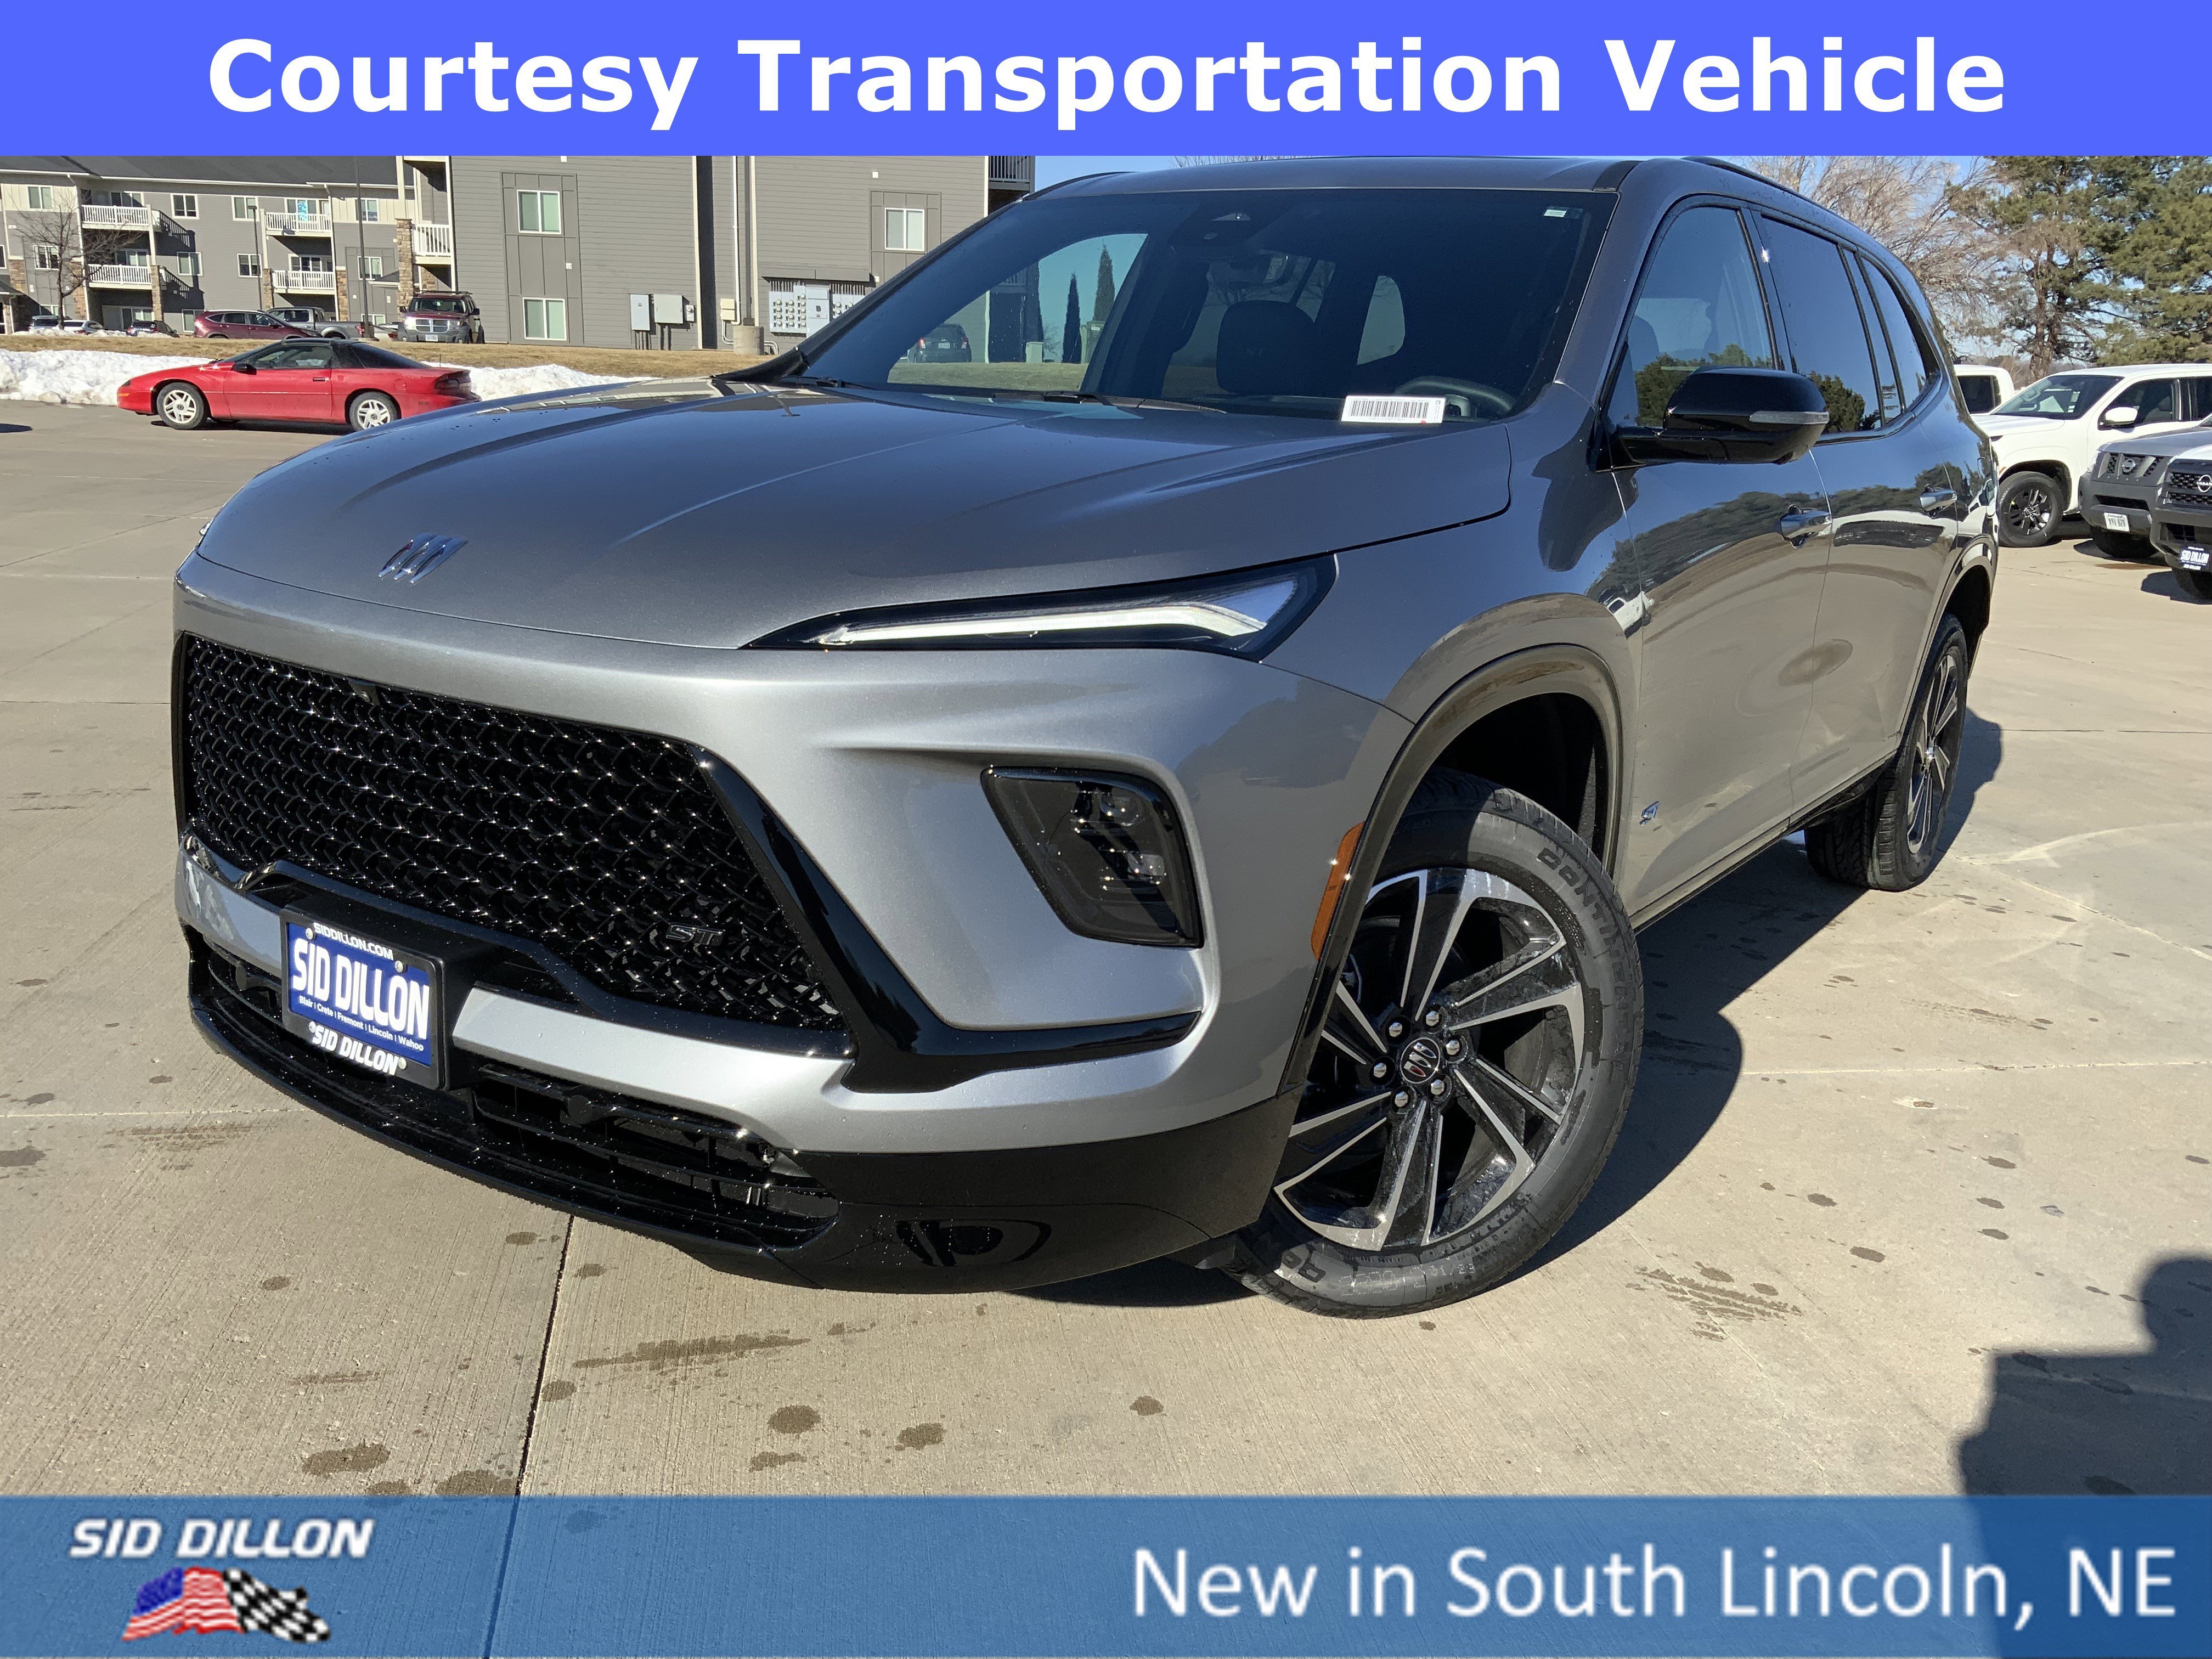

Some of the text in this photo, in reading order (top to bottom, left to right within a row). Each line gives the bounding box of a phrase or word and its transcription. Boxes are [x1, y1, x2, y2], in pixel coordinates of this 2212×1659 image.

[313, 922, 394, 961] SIDDILLON.COM
[665, 924, 726, 945] ST
[292, 938, 430, 1040] SID DILLON
[299, 995, 424, 1052] Blair Crete Fremont Lincoln Wahoo
[312, 1025, 399, 1076] SID DILLON
